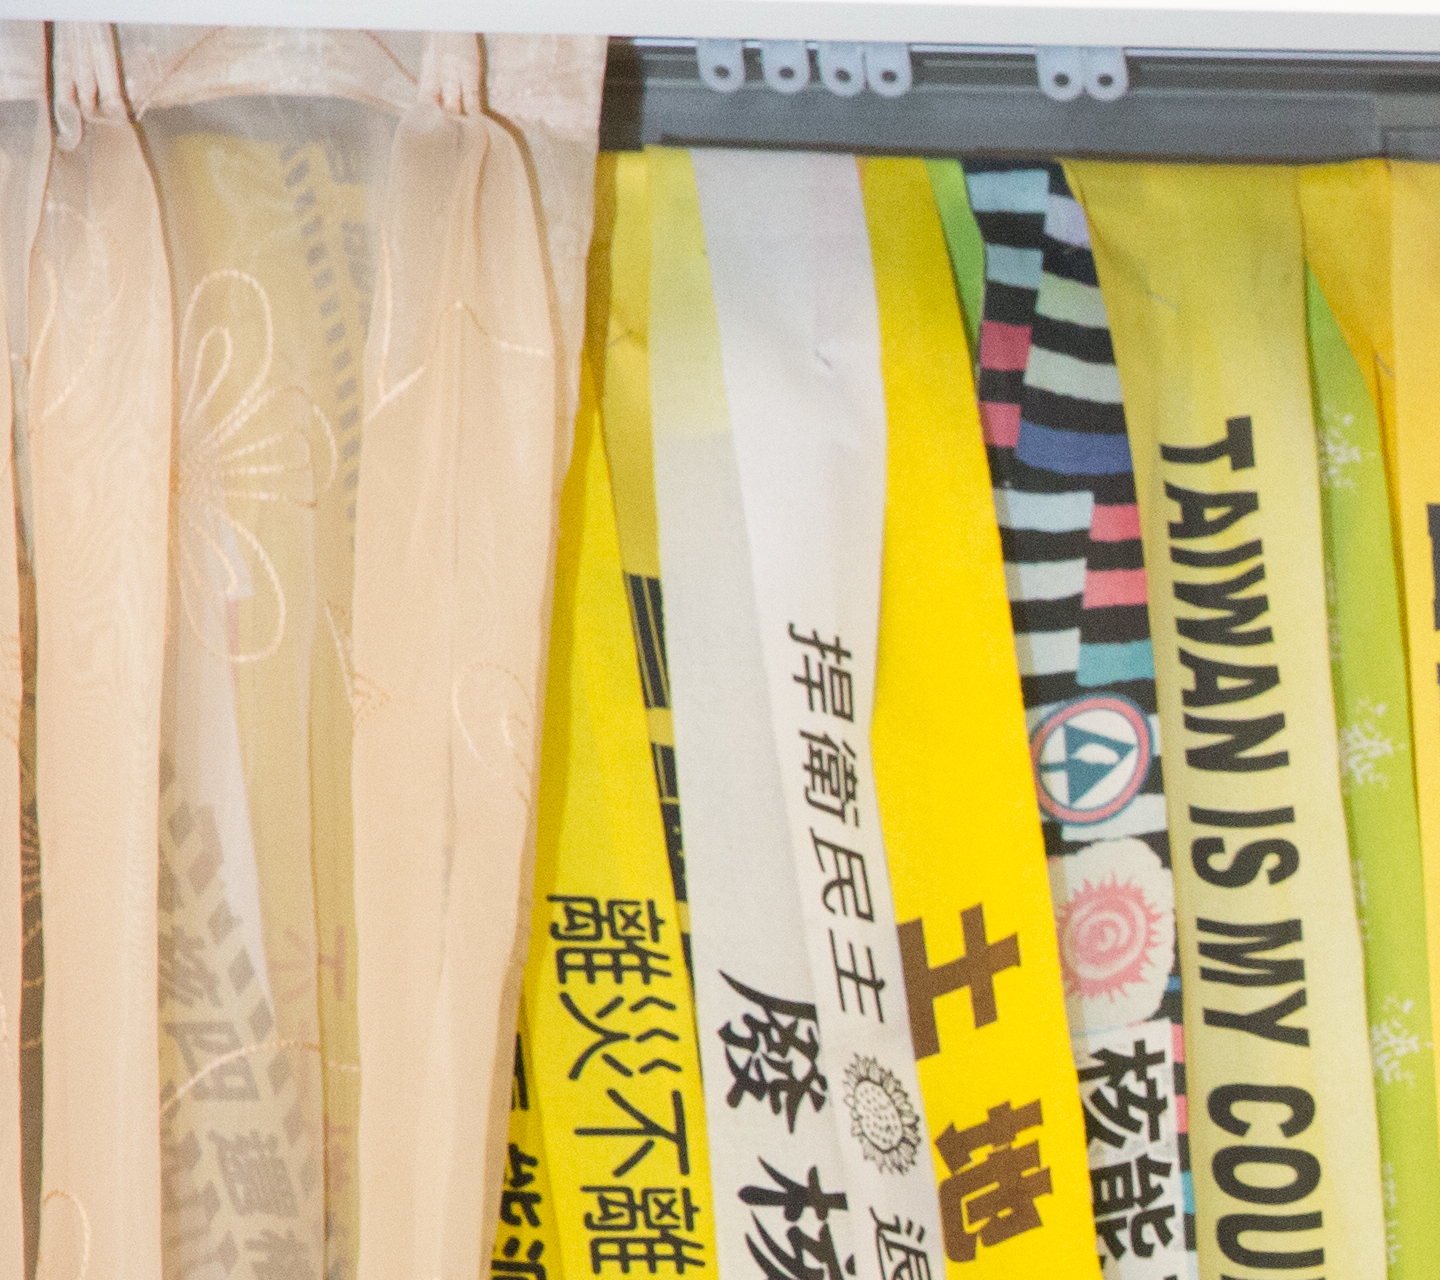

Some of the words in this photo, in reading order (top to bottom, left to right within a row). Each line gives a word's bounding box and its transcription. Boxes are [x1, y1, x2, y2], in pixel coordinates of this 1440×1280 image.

[1160, 415, 1292, 774] TAIWAN
[787, 620, 888, 1026] 捍衛民主
[1189, 804, 1301, 889] IS
[1196, 918, 1311, 1048] MY
